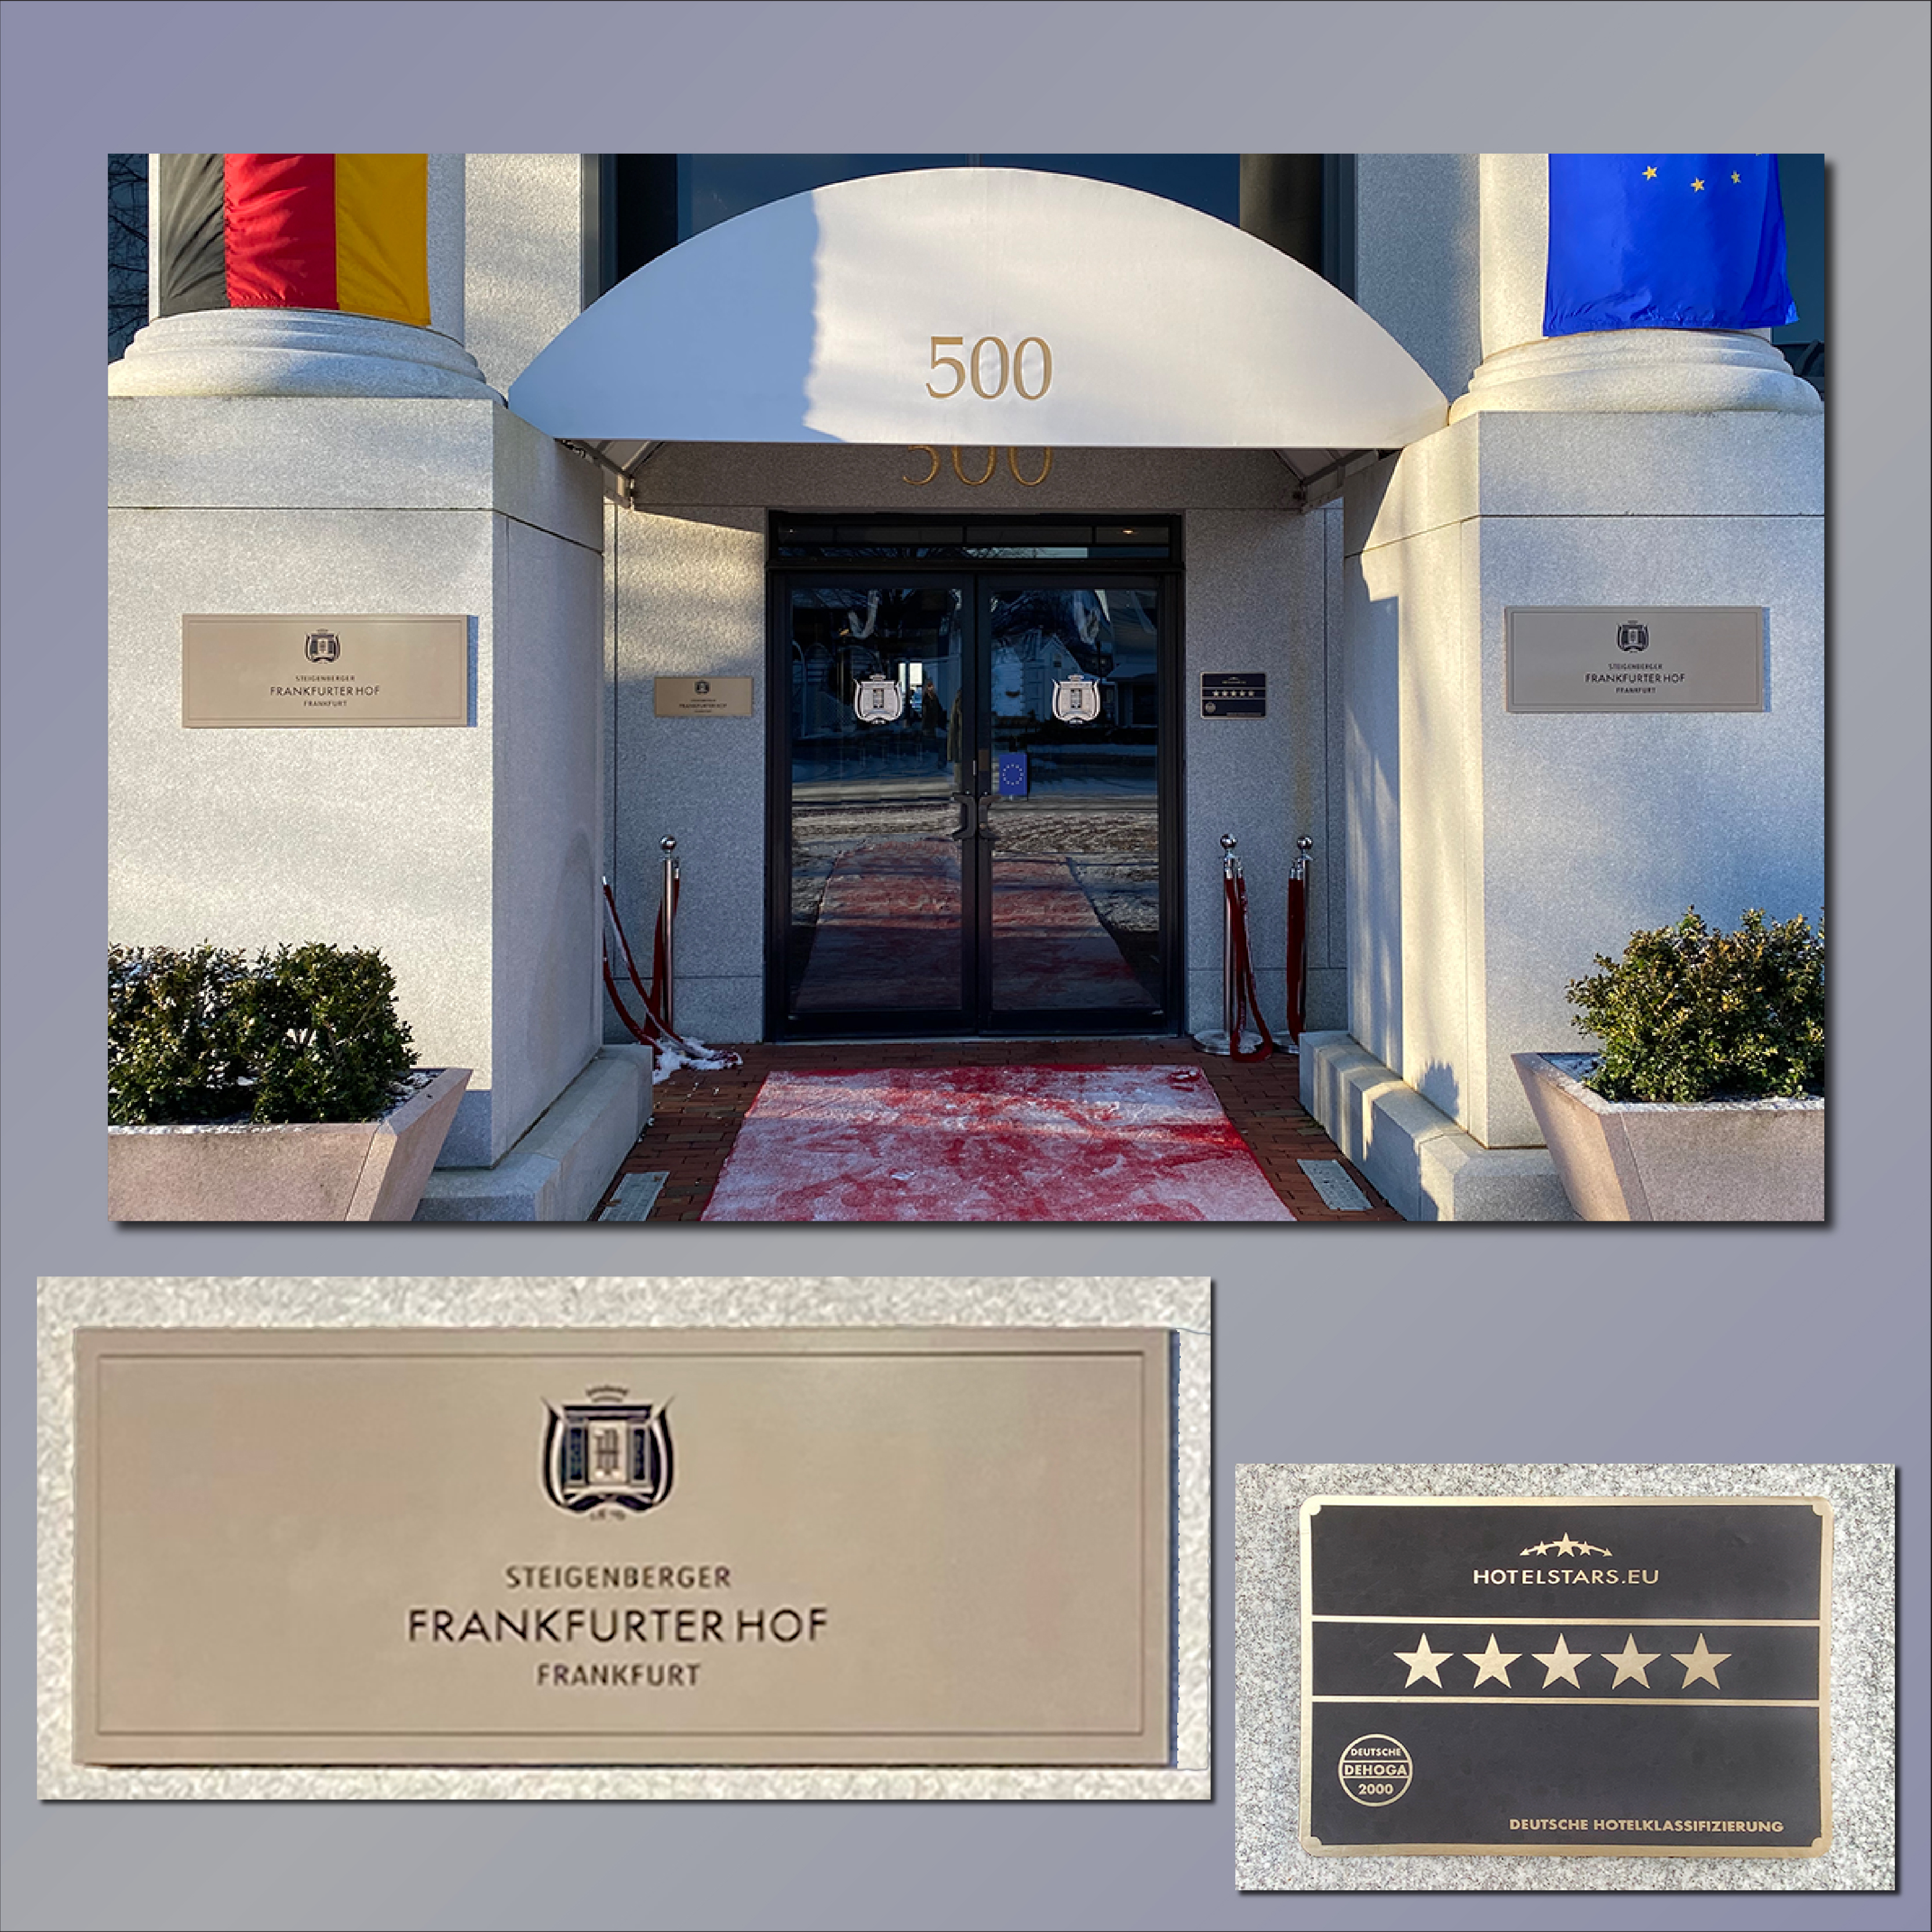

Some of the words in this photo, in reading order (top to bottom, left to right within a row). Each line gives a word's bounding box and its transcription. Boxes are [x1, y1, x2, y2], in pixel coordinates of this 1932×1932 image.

[926, 336, 1052, 400] 500
[1663, 673, 1685, 683] HOF
[270, 686, 354, 696] FRANKFURTER
[356, 685, 380, 696] HOF
[505, 1565, 732, 1589] STEIGENBERGER
[1473, 1569, 1659, 1585] HOTELSTARS.EU
[409, 1609, 723, 1642] FRANKFURTER
[737, 1608, 828, 1642] HOF
[537, 1664, 701, 1686] FRANKFURT
[1351, 1747, 1401, 1757] DEUTSCHE
[1344, 1764, 1407, 1775] DEHOGA
[1358, 1783, 1394, 1795] 2000
[1509, 1818, 1588, 1831] DEUTSCHE
[1593, 1819, 1785, 1832] HOTELKLASSIFIZIERUNG
